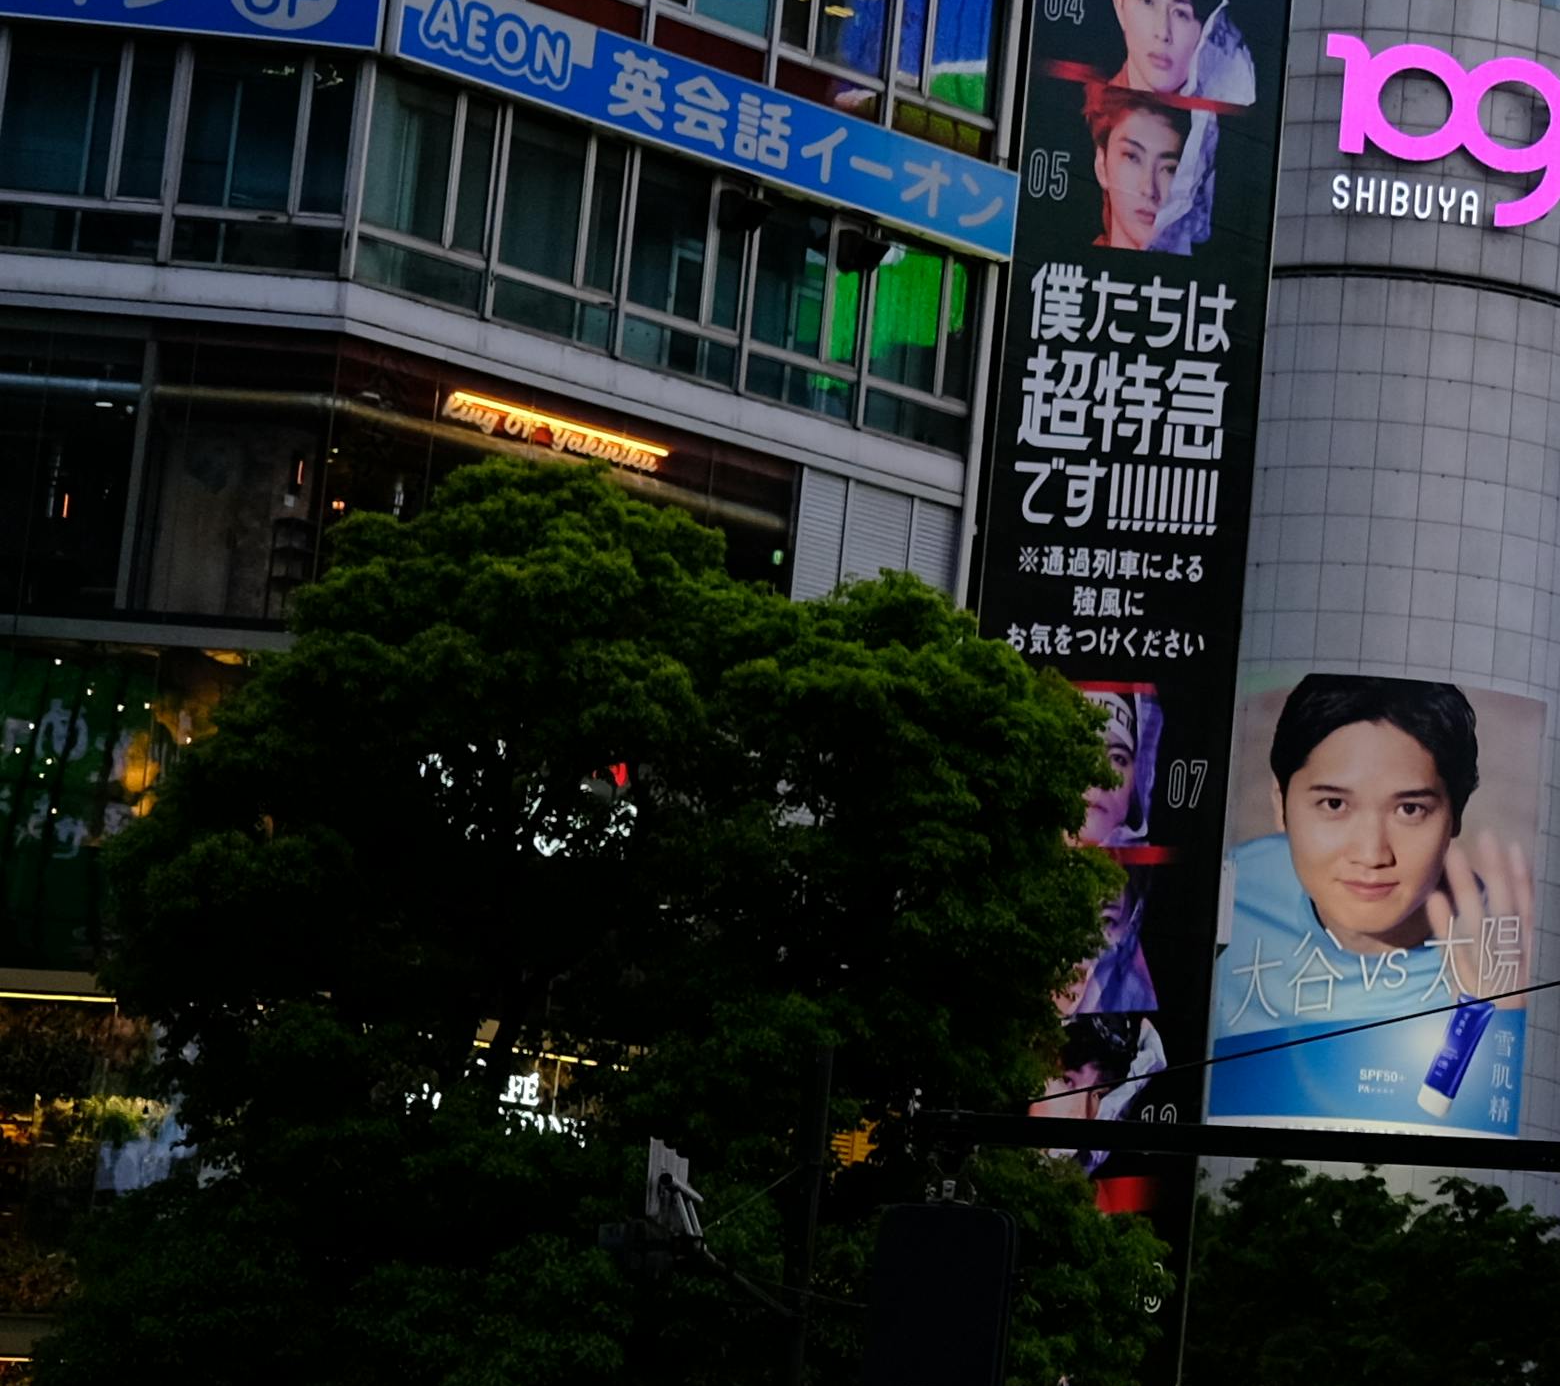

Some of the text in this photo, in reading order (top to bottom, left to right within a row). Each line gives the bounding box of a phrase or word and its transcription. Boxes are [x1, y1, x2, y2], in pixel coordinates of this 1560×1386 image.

[1027, 148, 1071, 200] 05
[1332, 173, 1480, 226] SHIBUYA
[1030, 262, 1237, 353] 僕たちは
[1016, 345, 1231, 461] 超特急
[1073, 586, 1144, 617] 強風に
[1006, 623, 1206, 658] お気をつけください
[1167, 759, 1209, 810] 07
[1488, 1029, 1515, 1124] 雪肌精
